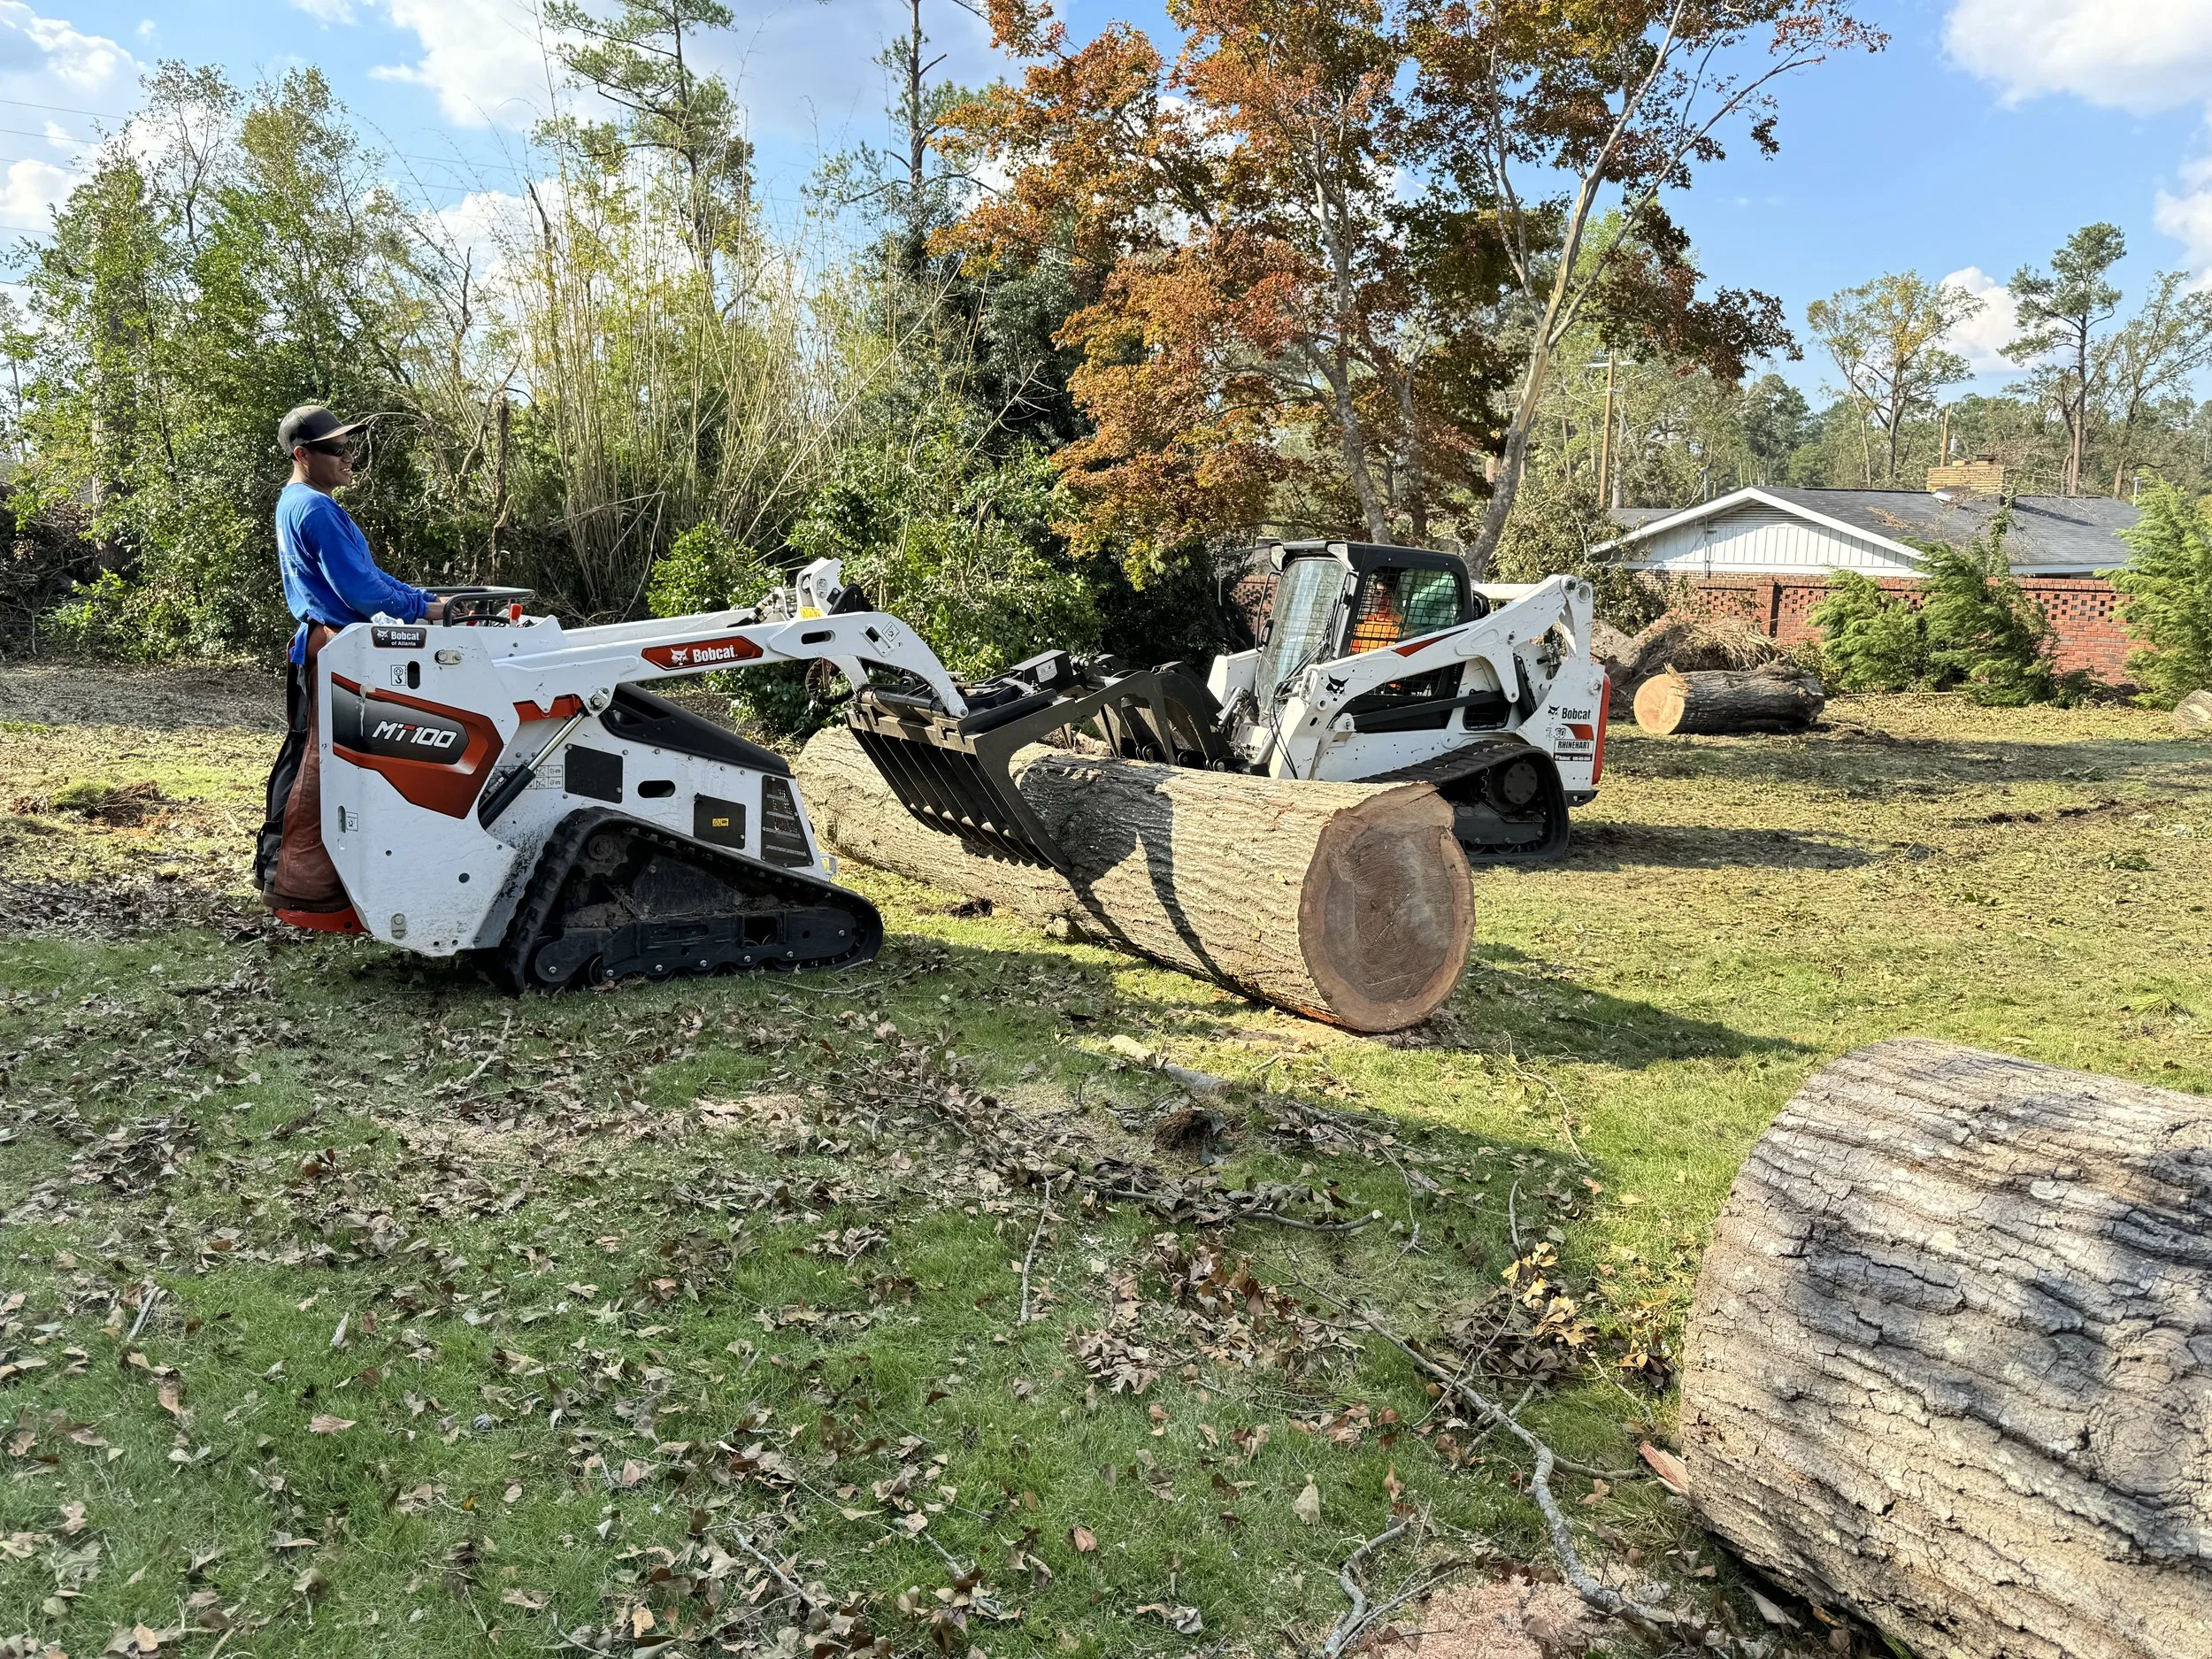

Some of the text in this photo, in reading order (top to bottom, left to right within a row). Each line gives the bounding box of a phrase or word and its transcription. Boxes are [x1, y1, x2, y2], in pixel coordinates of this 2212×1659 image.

[391, 631, 419, 641] Bobcat
[692, 645, 735, 663] Bobcat
[1562, 708, 1591, 719] Bobcat
[372, 720, 457, 749] MT100
[1557, 741, 1590, 749] RHINEHART
